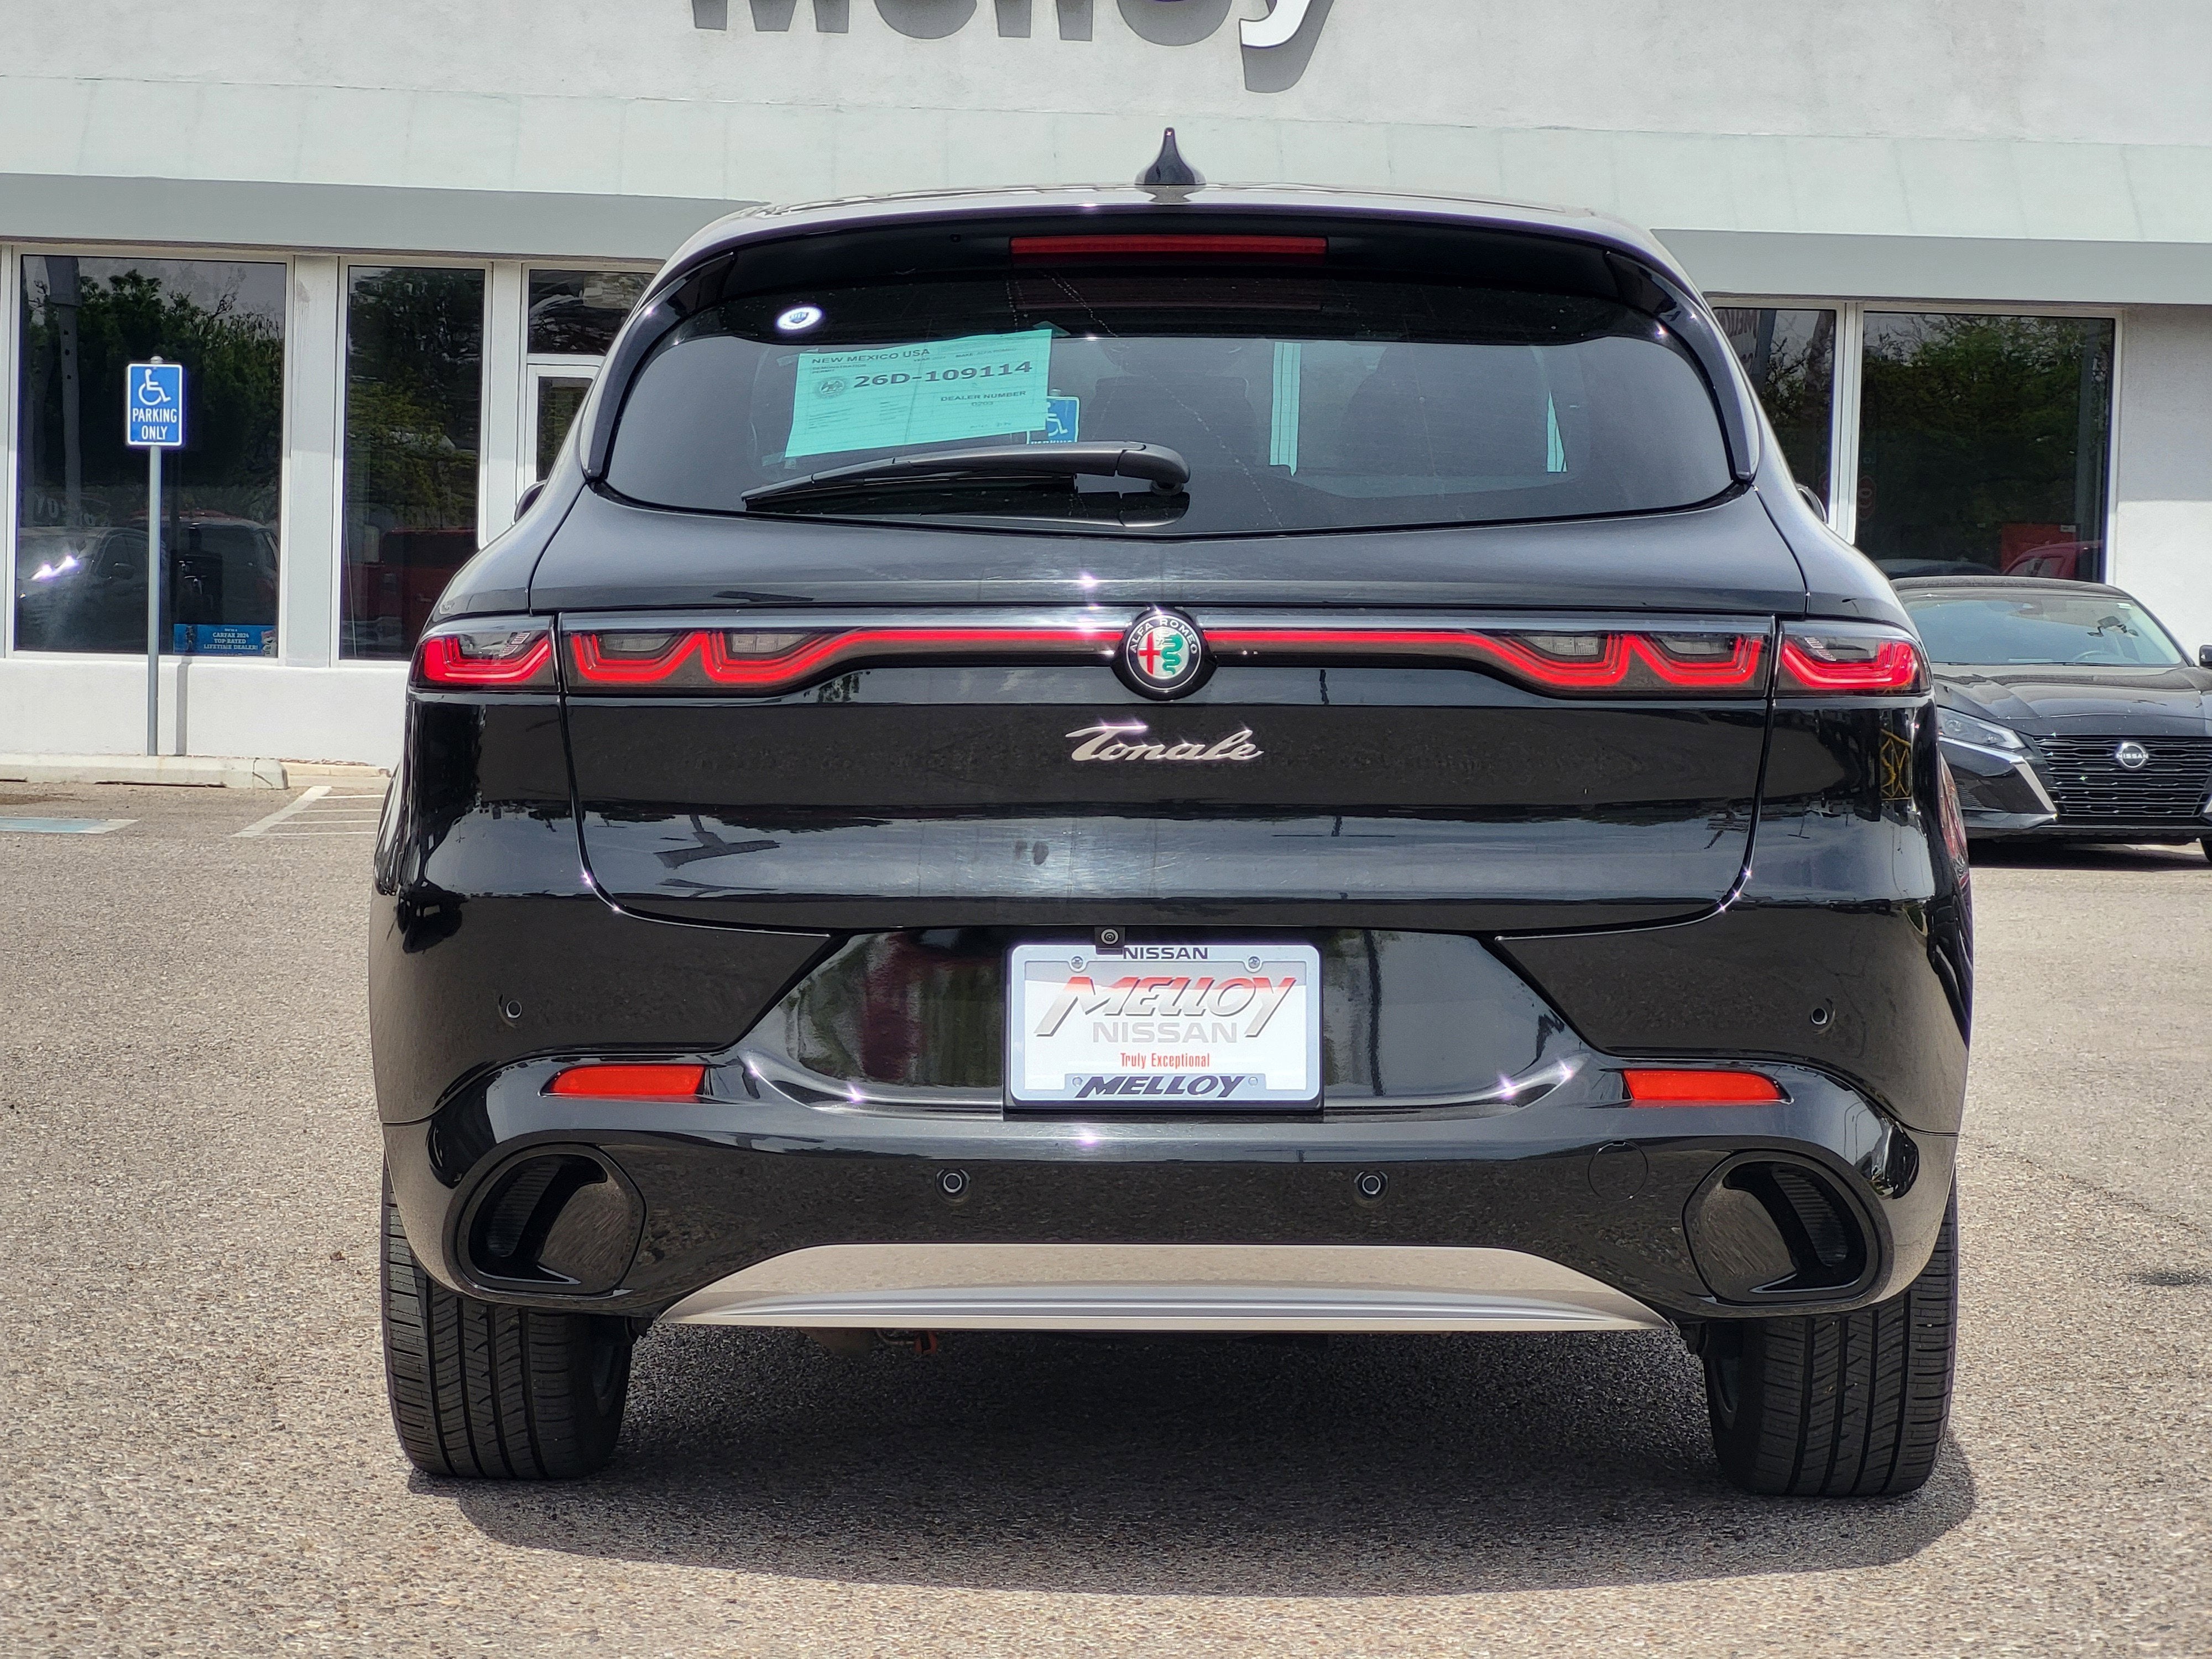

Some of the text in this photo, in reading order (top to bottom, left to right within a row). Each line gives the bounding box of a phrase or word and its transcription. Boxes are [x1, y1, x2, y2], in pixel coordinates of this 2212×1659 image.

[847, 353, 899, 362] MEXICO
[903, 349, 930, 358] USA
[854, 361, 1032, 388] 26D-109114
[132, 408, 177, 423] PARKING
[142, 425, 168, 440] ONLY
[1129, 618, 1198, 654] ALFA ROMEO
[1065, 725, 1265, 761] Tonale
[1123, 947, 1208, 959] NISSAN
[1034, 977, 1297, 1037] MELLOY
[1092, 1022, 1238, 1044] NISSAN
[1120, 1053, 1210, 1068] Truly Exceptional
[1075, 1076, 1246, 1098] MELLOY
